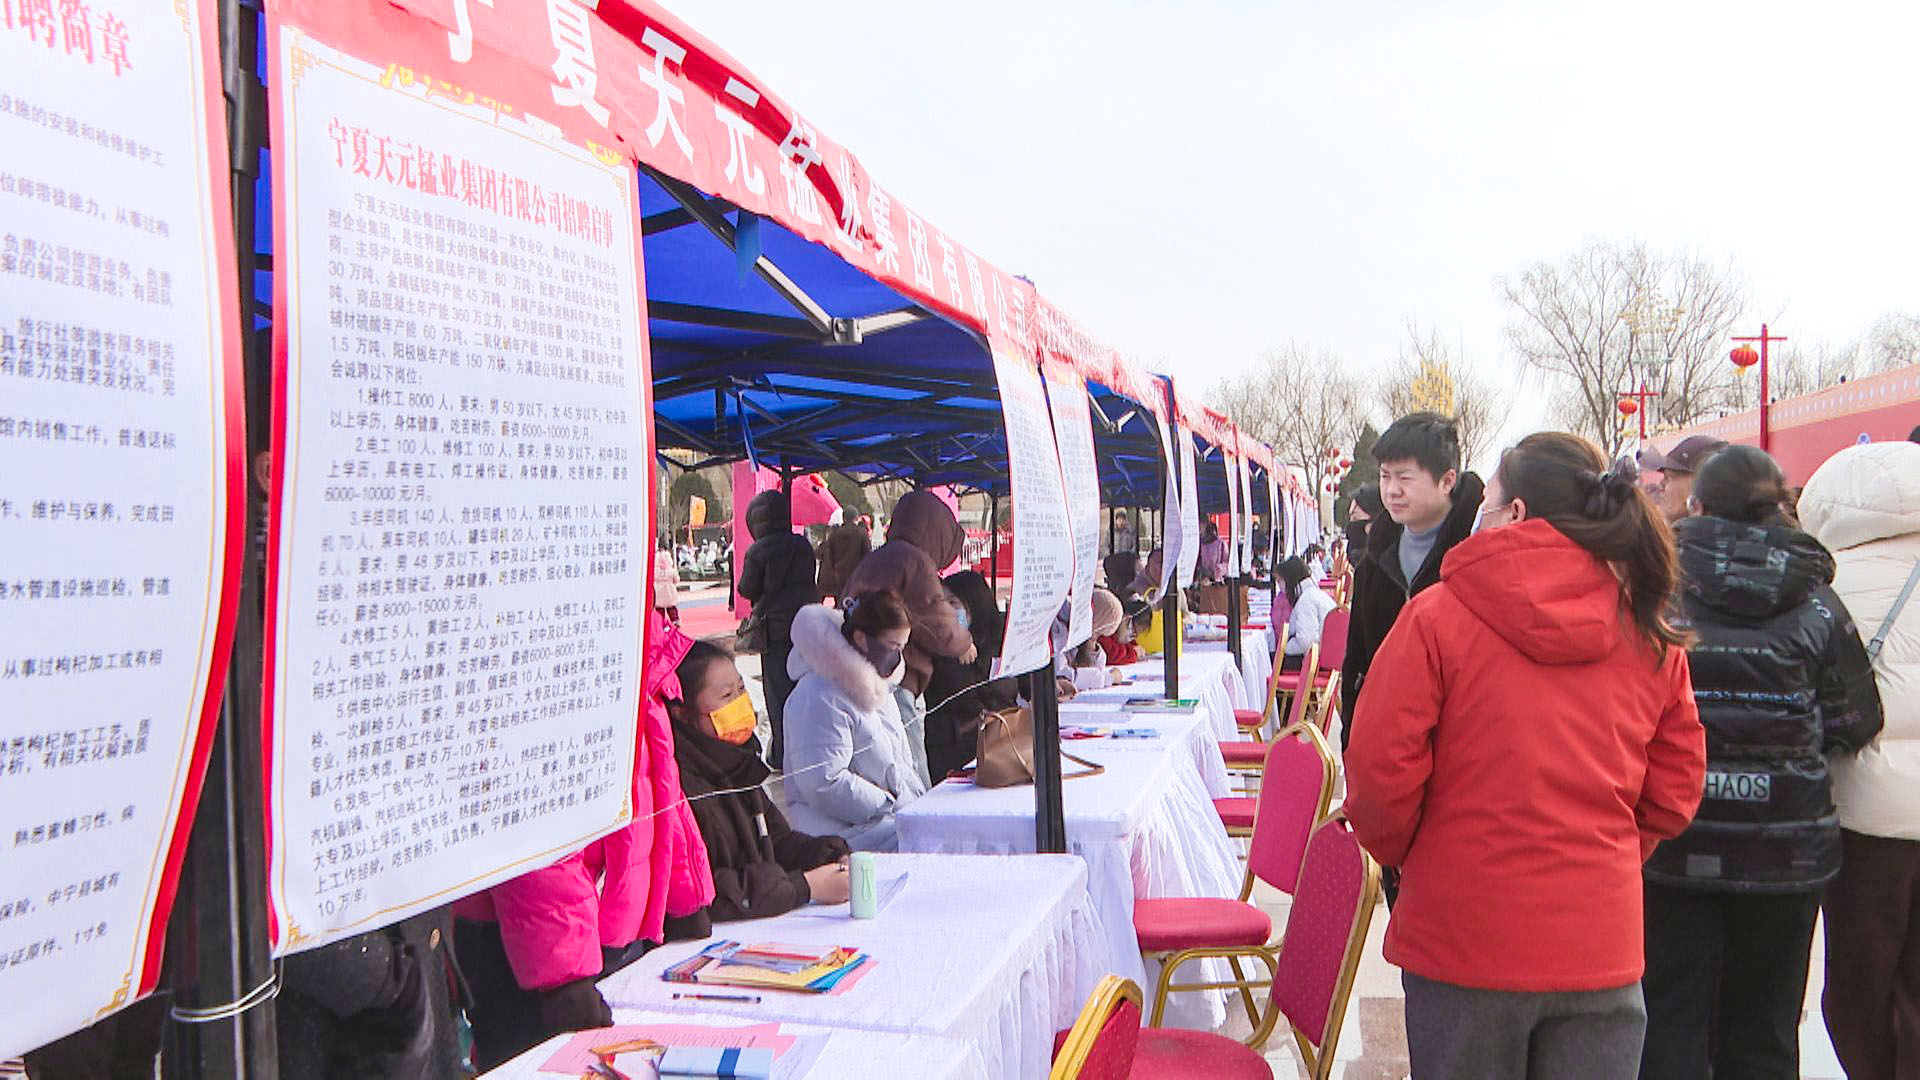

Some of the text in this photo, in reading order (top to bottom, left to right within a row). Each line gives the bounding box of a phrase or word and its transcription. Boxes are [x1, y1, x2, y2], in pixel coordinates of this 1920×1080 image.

[328, 116, 614, 250] 宁夏天元锰业集团有限公司招聘启事
